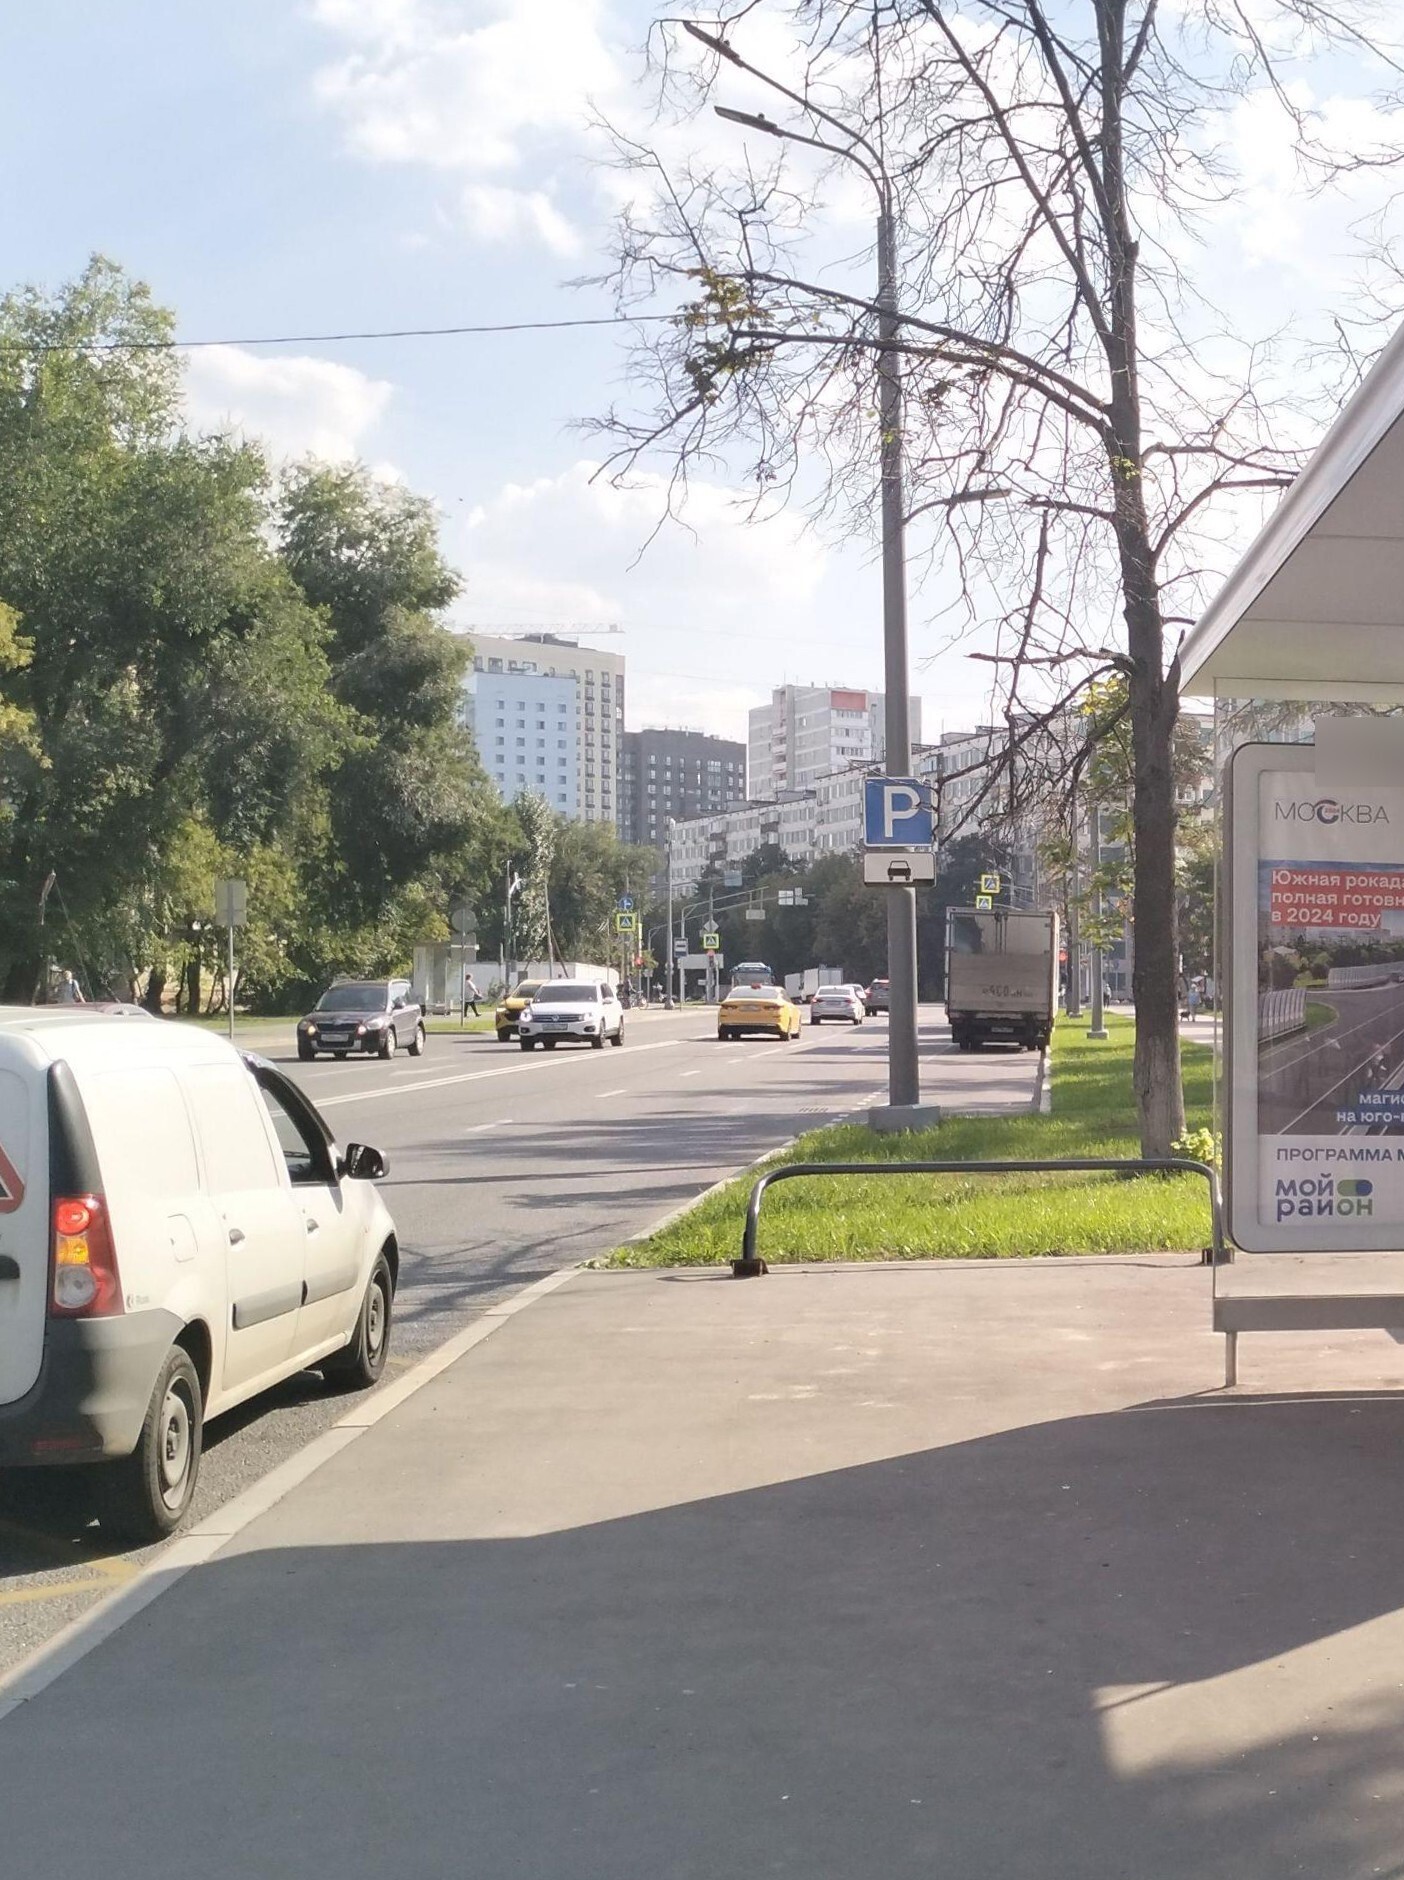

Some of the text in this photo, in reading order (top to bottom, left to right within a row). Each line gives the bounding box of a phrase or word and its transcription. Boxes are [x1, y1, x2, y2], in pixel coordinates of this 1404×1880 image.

[884, 785, 920, 837] P
[1275, 799, 1389, 825] МОСКВА
[1272, 870, 1341, 886] Южная
[1271, 892, 1338, 905] полная
[1271, 908, 1381, 927] в 2024 году
[1336, 1112, 1357, 1123] на
[1276, 1148, 1393, 1162] ПРОГРАММА
[1275, 1172, 1334, 1196] мой
